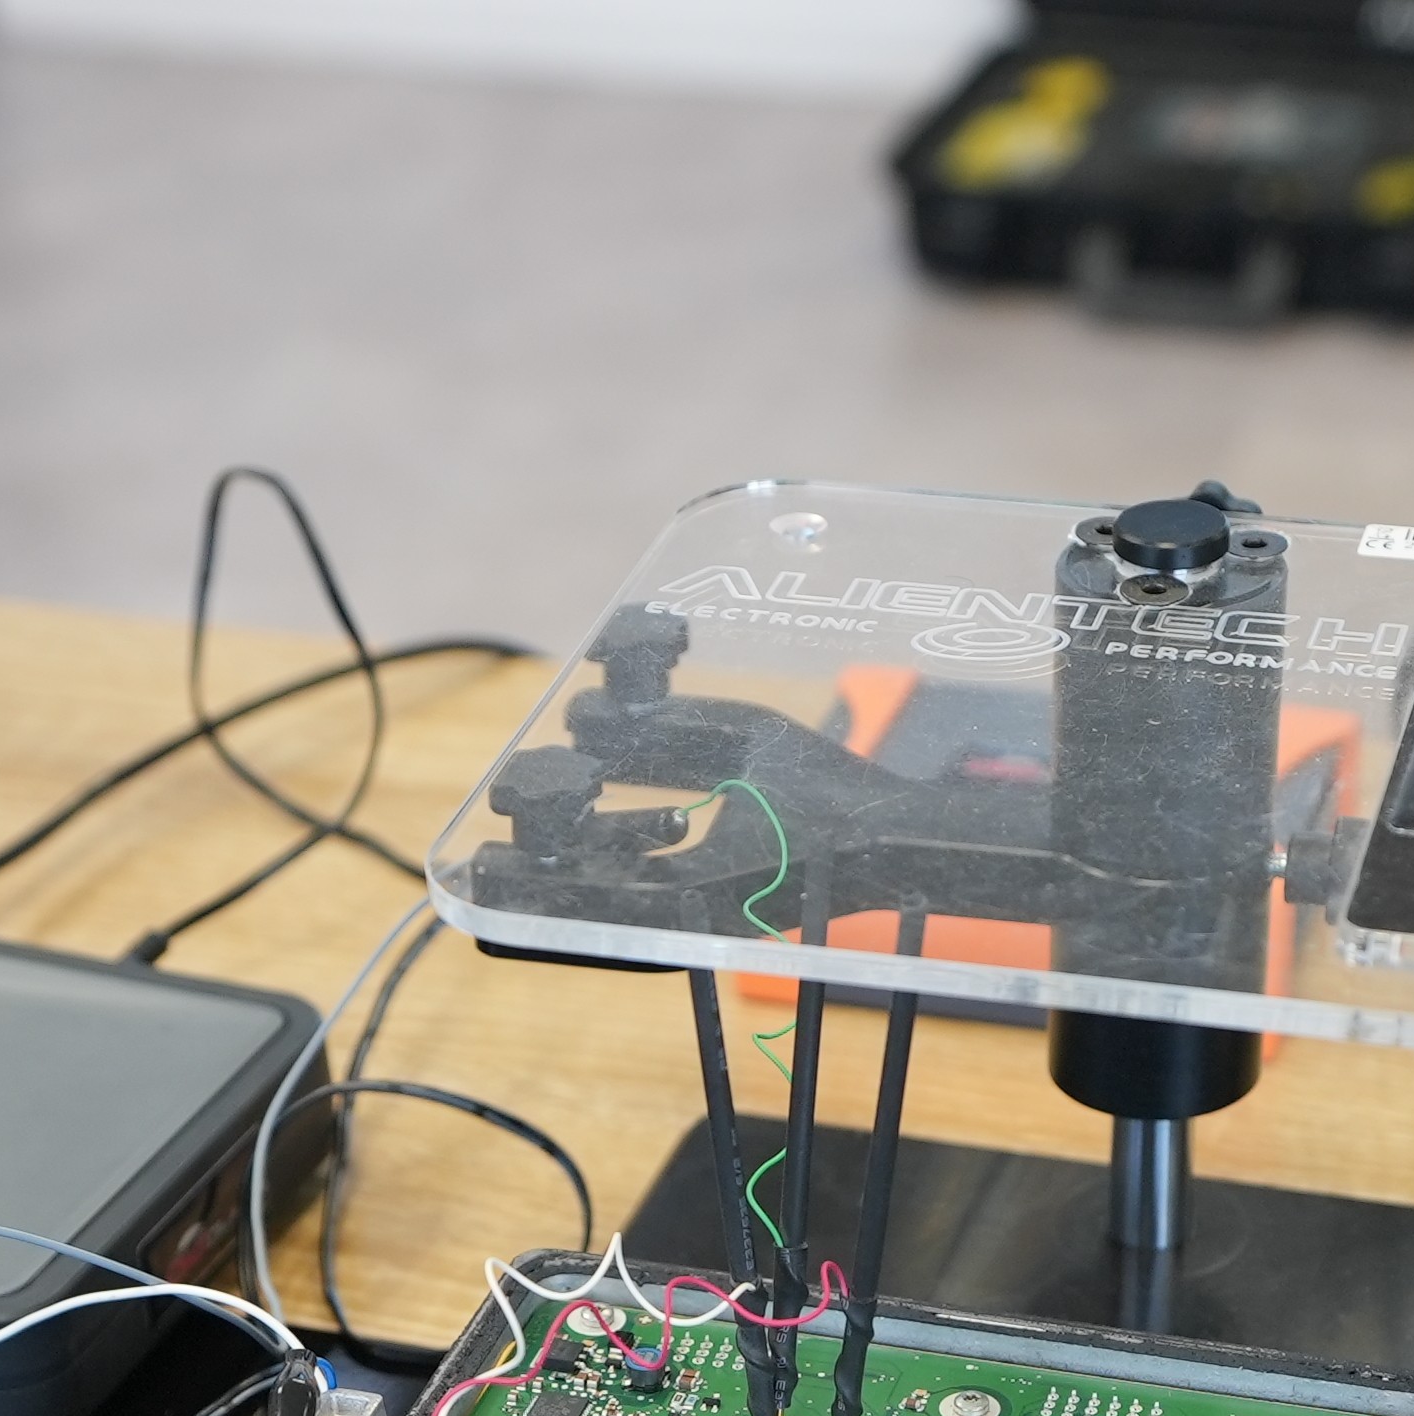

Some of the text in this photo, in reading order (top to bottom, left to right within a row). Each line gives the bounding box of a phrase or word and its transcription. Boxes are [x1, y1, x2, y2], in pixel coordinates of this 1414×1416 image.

[644, 599, 1398, 680] ELECTRONIC PERFORMANCE
[658, 565, 1409, 657] ALIENTECH
